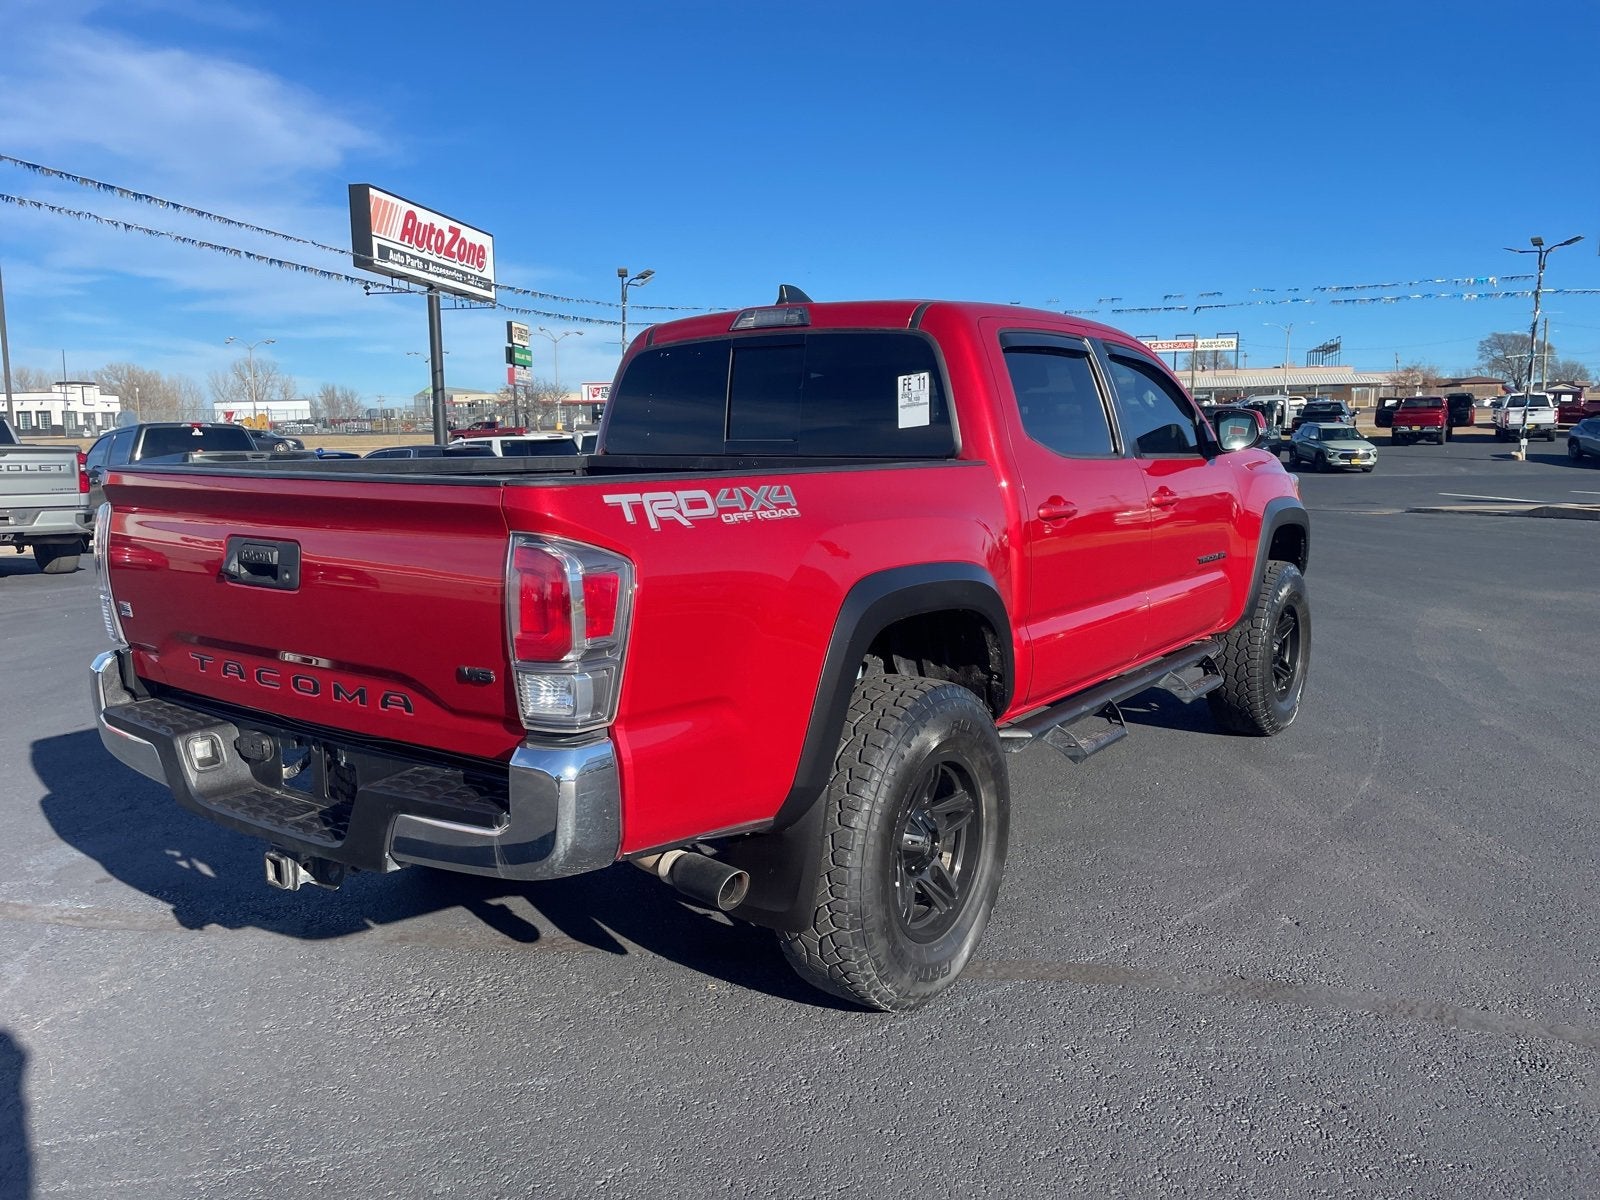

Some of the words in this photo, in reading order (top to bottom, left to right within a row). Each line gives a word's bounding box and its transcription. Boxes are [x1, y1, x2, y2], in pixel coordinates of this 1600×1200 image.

[400, 210, 488, 270] AutoZone
[389, 249, 405, 264] Auto
[406, 255, 424, 269] Parts
[903, 377, 912, 392] FE
[917, 375, 926, 390] 11
[603, 489, 717, 531] TRD
[721, 511, 755, 524] OFF
[756, 507, 801, 521] ROAD
[189, 651, 415, 716] TACOMA
